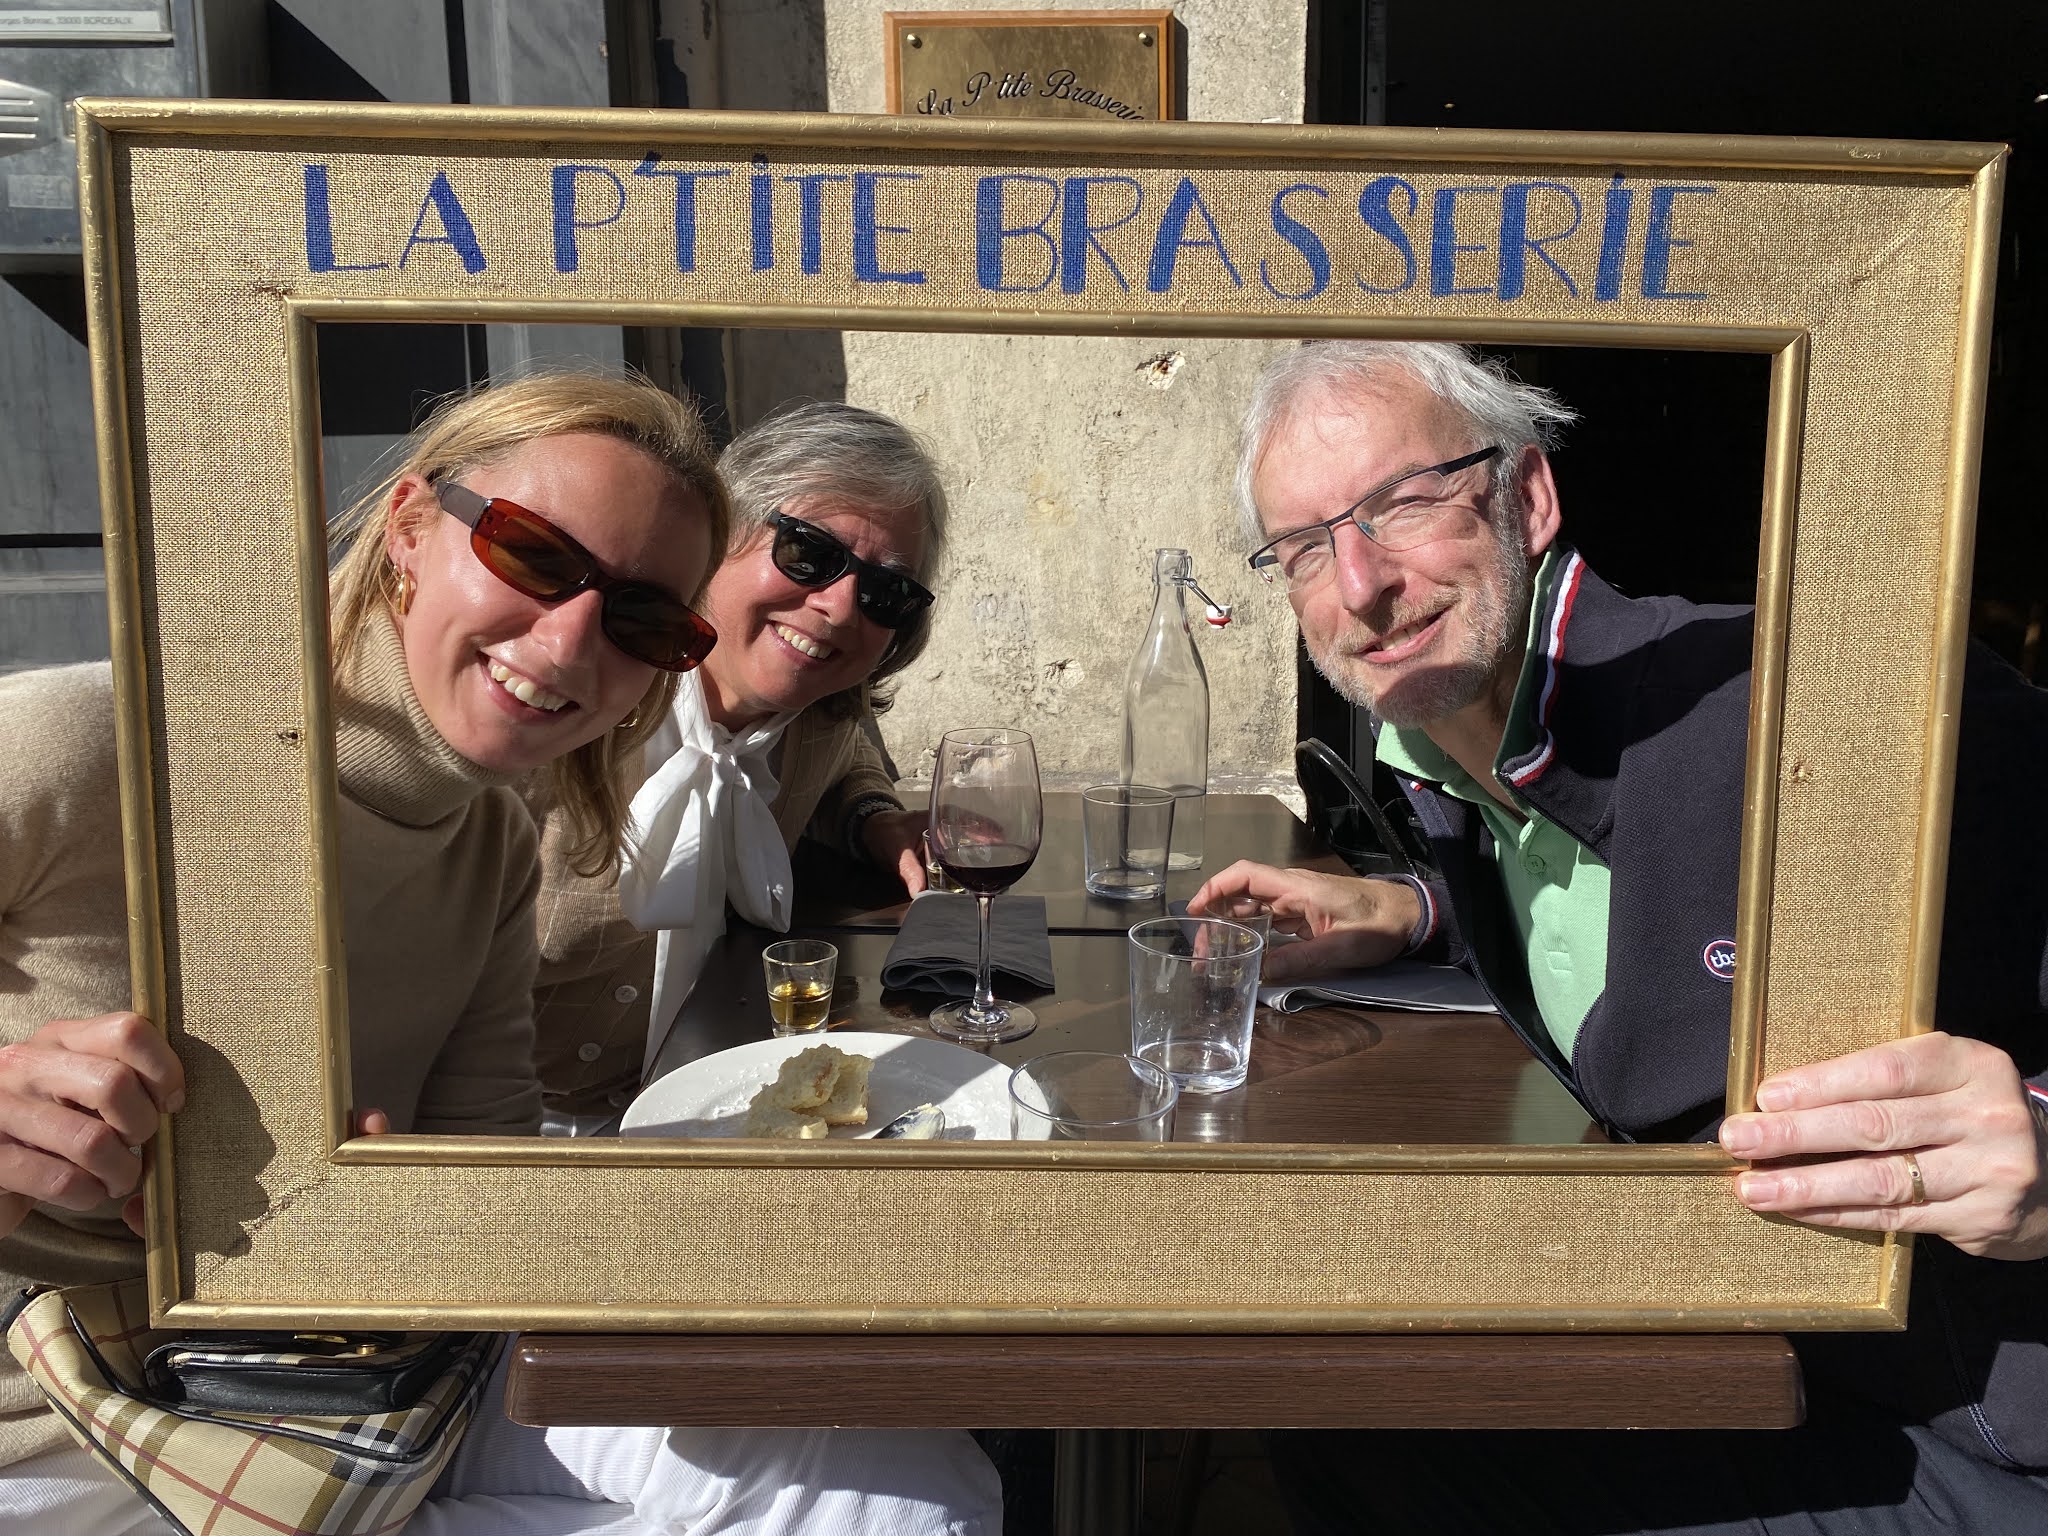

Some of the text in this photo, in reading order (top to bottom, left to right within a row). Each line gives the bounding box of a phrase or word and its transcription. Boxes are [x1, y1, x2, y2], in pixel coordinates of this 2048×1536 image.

[84, 16, 134, 25] BORDEAUX
[917, 88, 953, 115] La
[304, 164, 487, 275] LA
